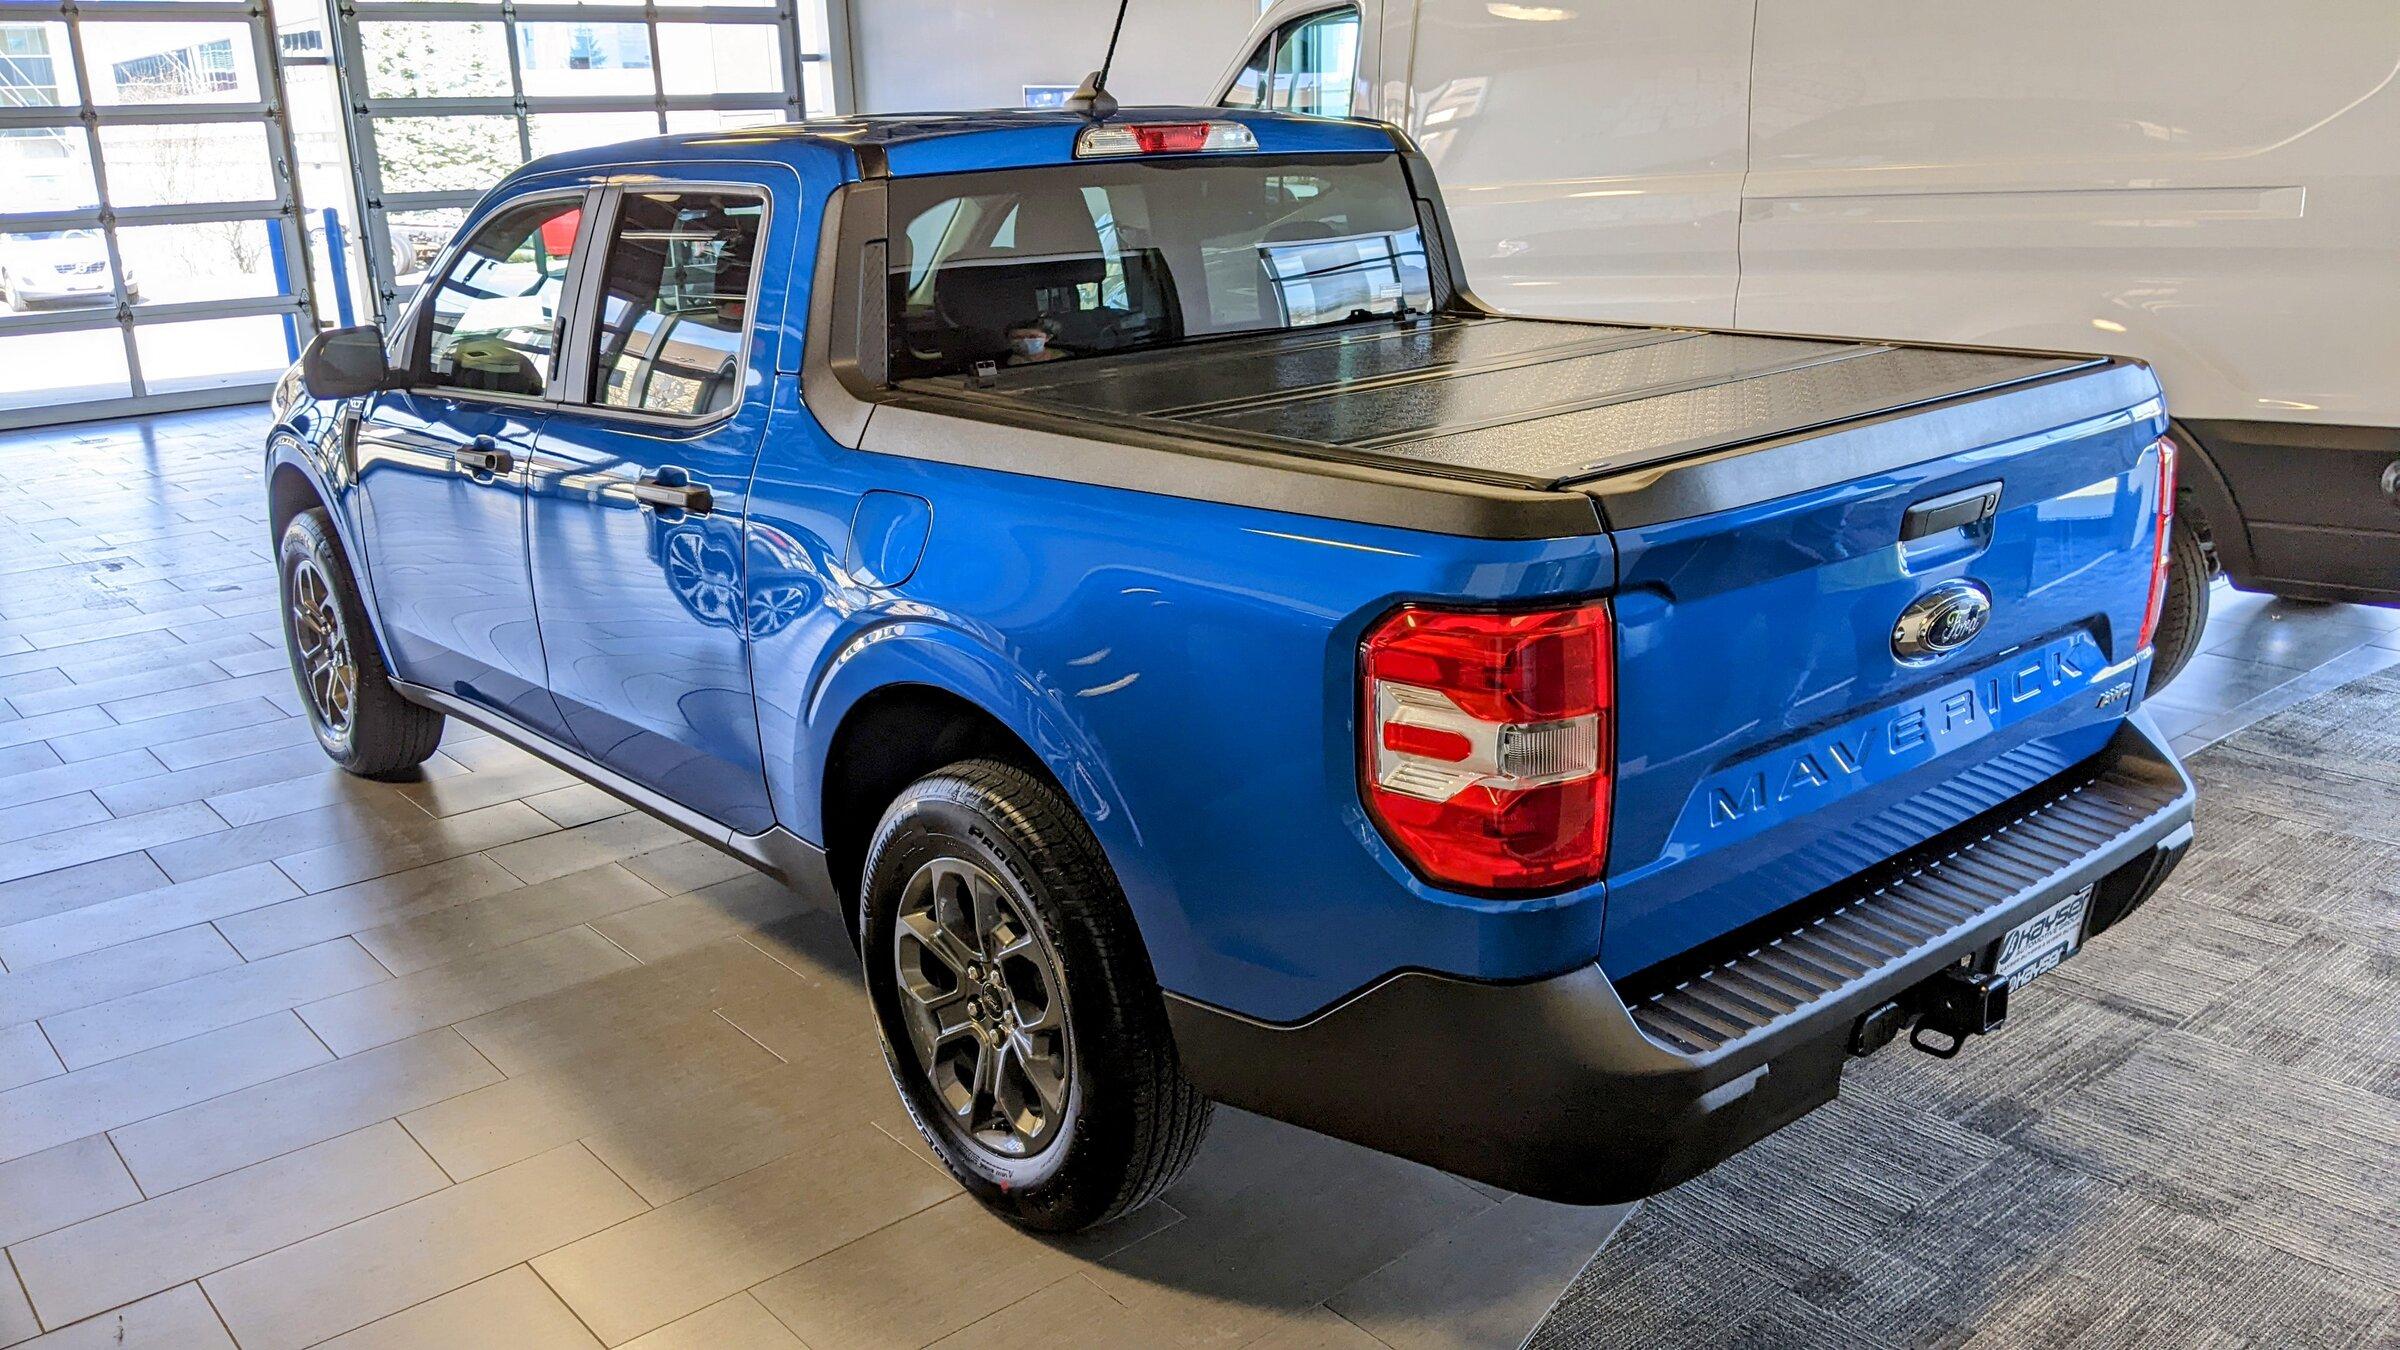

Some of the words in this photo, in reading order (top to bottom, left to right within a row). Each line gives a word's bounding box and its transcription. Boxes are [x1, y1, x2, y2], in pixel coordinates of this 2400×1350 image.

[1941, 609, 1979, 644] Ford
[2095, 681, 2132, 709] AWD
[1708, 631, 2095, 828] MAVERICK
